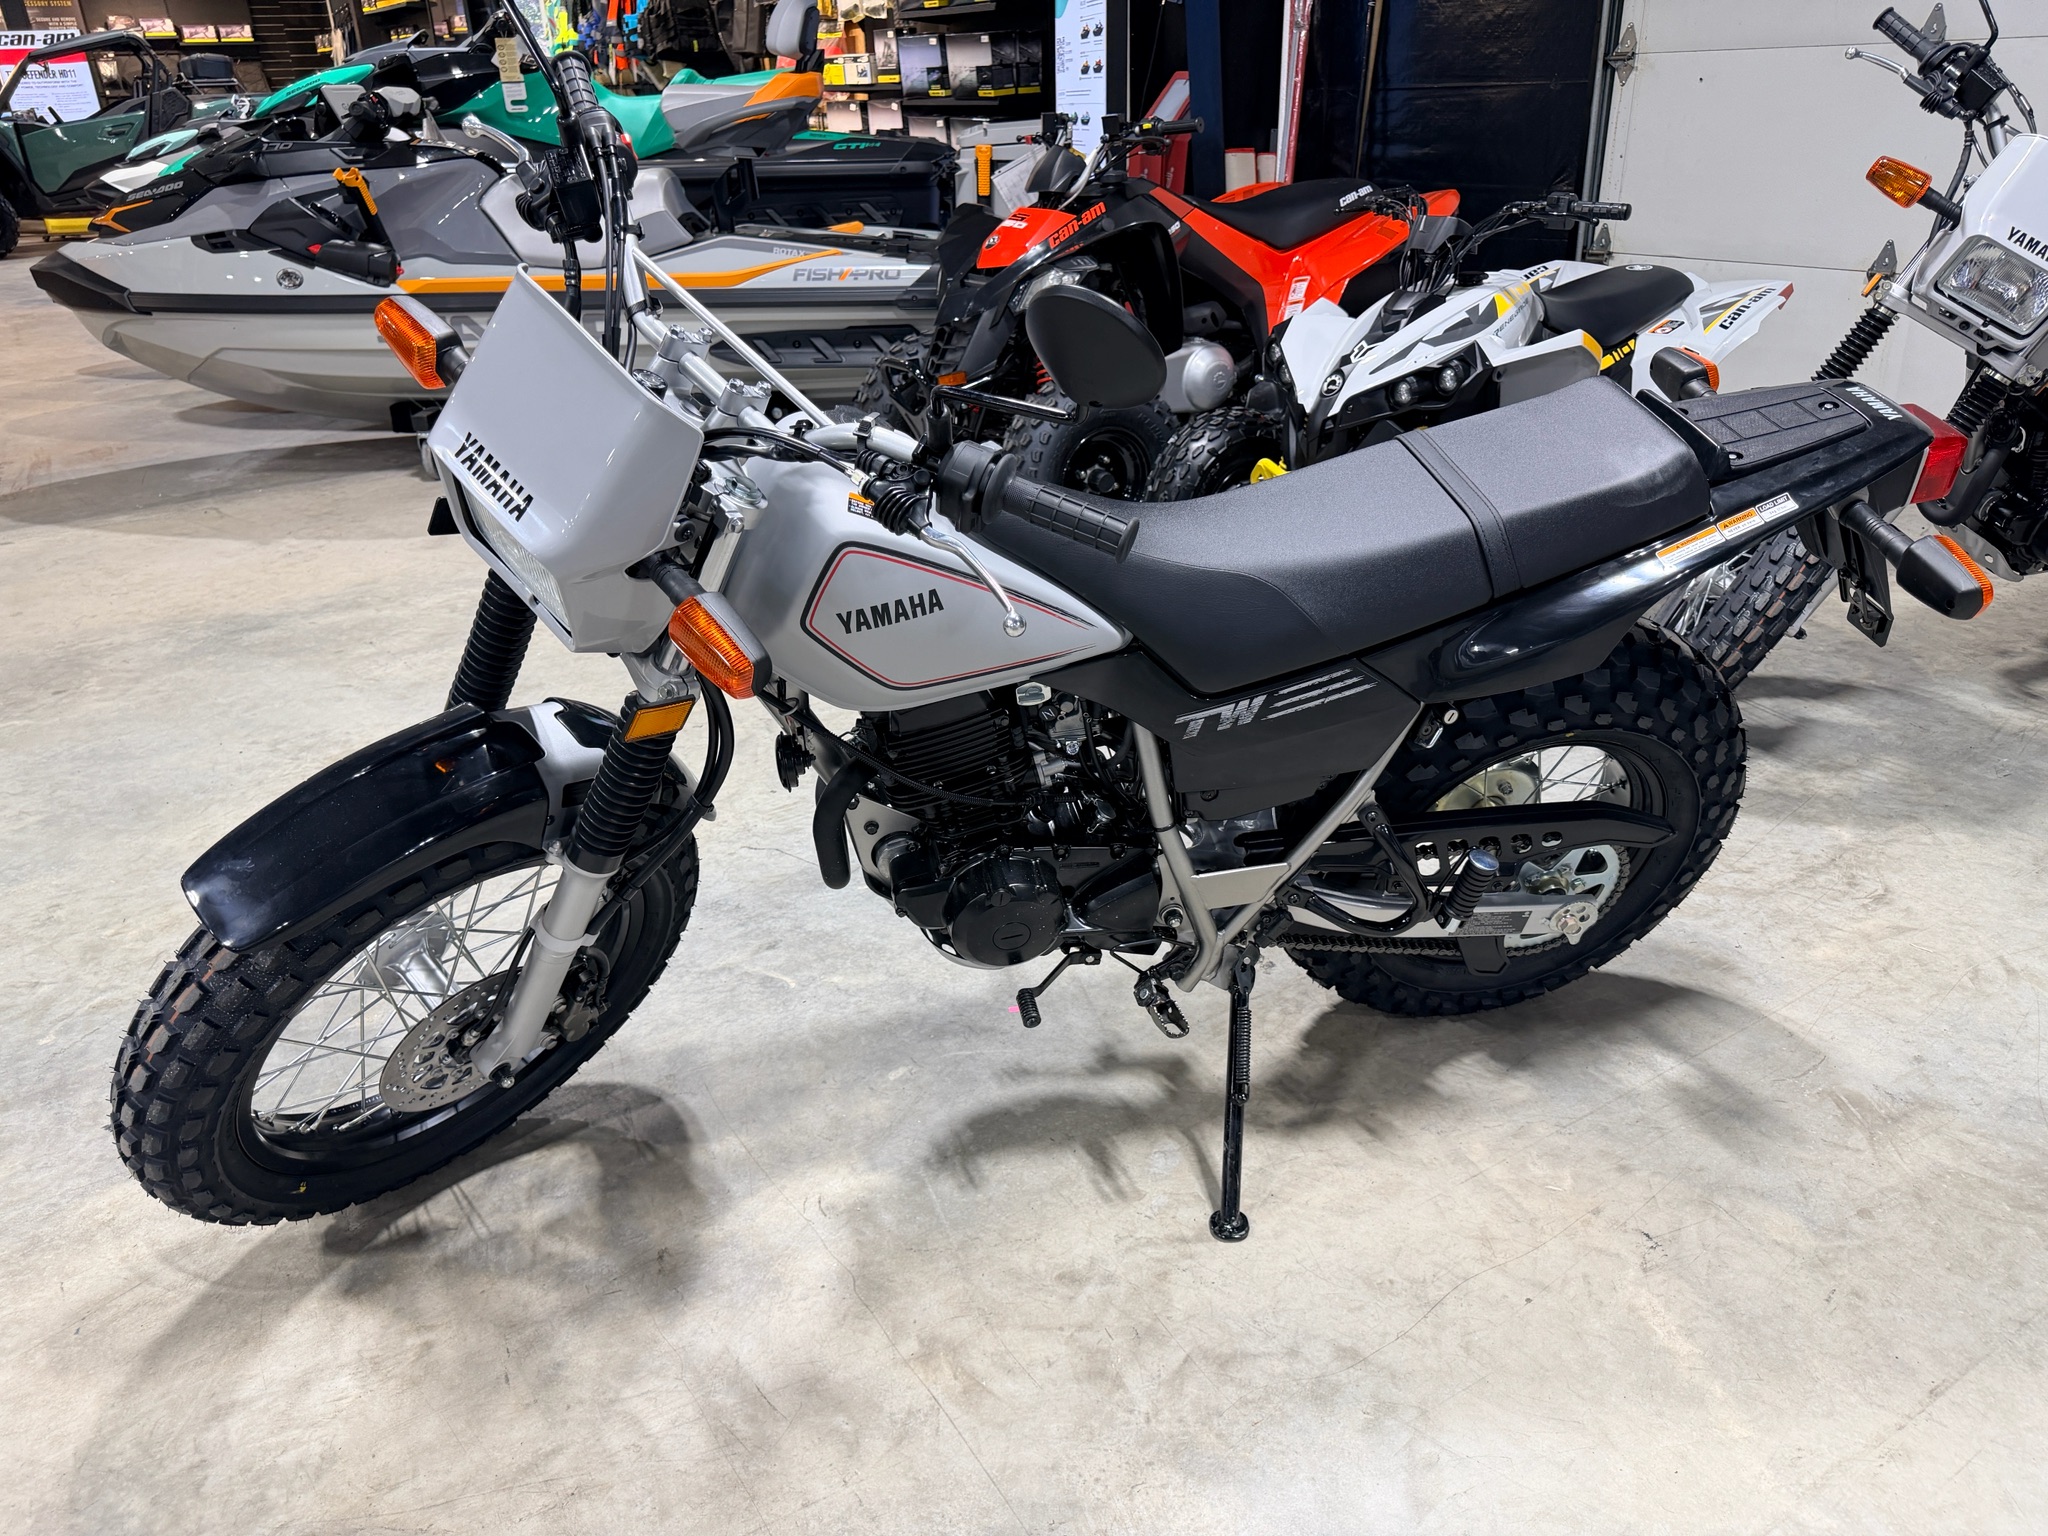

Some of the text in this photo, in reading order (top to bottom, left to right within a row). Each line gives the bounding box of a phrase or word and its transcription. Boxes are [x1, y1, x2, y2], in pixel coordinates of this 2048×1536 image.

[262, 142, 293, 151] 170
[1338, 184, 1374, 208] can-am
[1047, 201, 1107, 250] can-am
[773, 247, 806, 257] ROTAX
[1718, 287, 1777, 331] can-am
[1845, 386, 1904, 421] YAMAHA
[454, 431, 535, 522] YAMAHA
[1728, 511, 1754, 526] WARNING
[1758, 501, 1774, 513] LOAD
[1773, 494, 1789, 507] LIMIT
[836, 588, 945, 634] YAMAHA
[1174, 694, 1268, 740] TW
